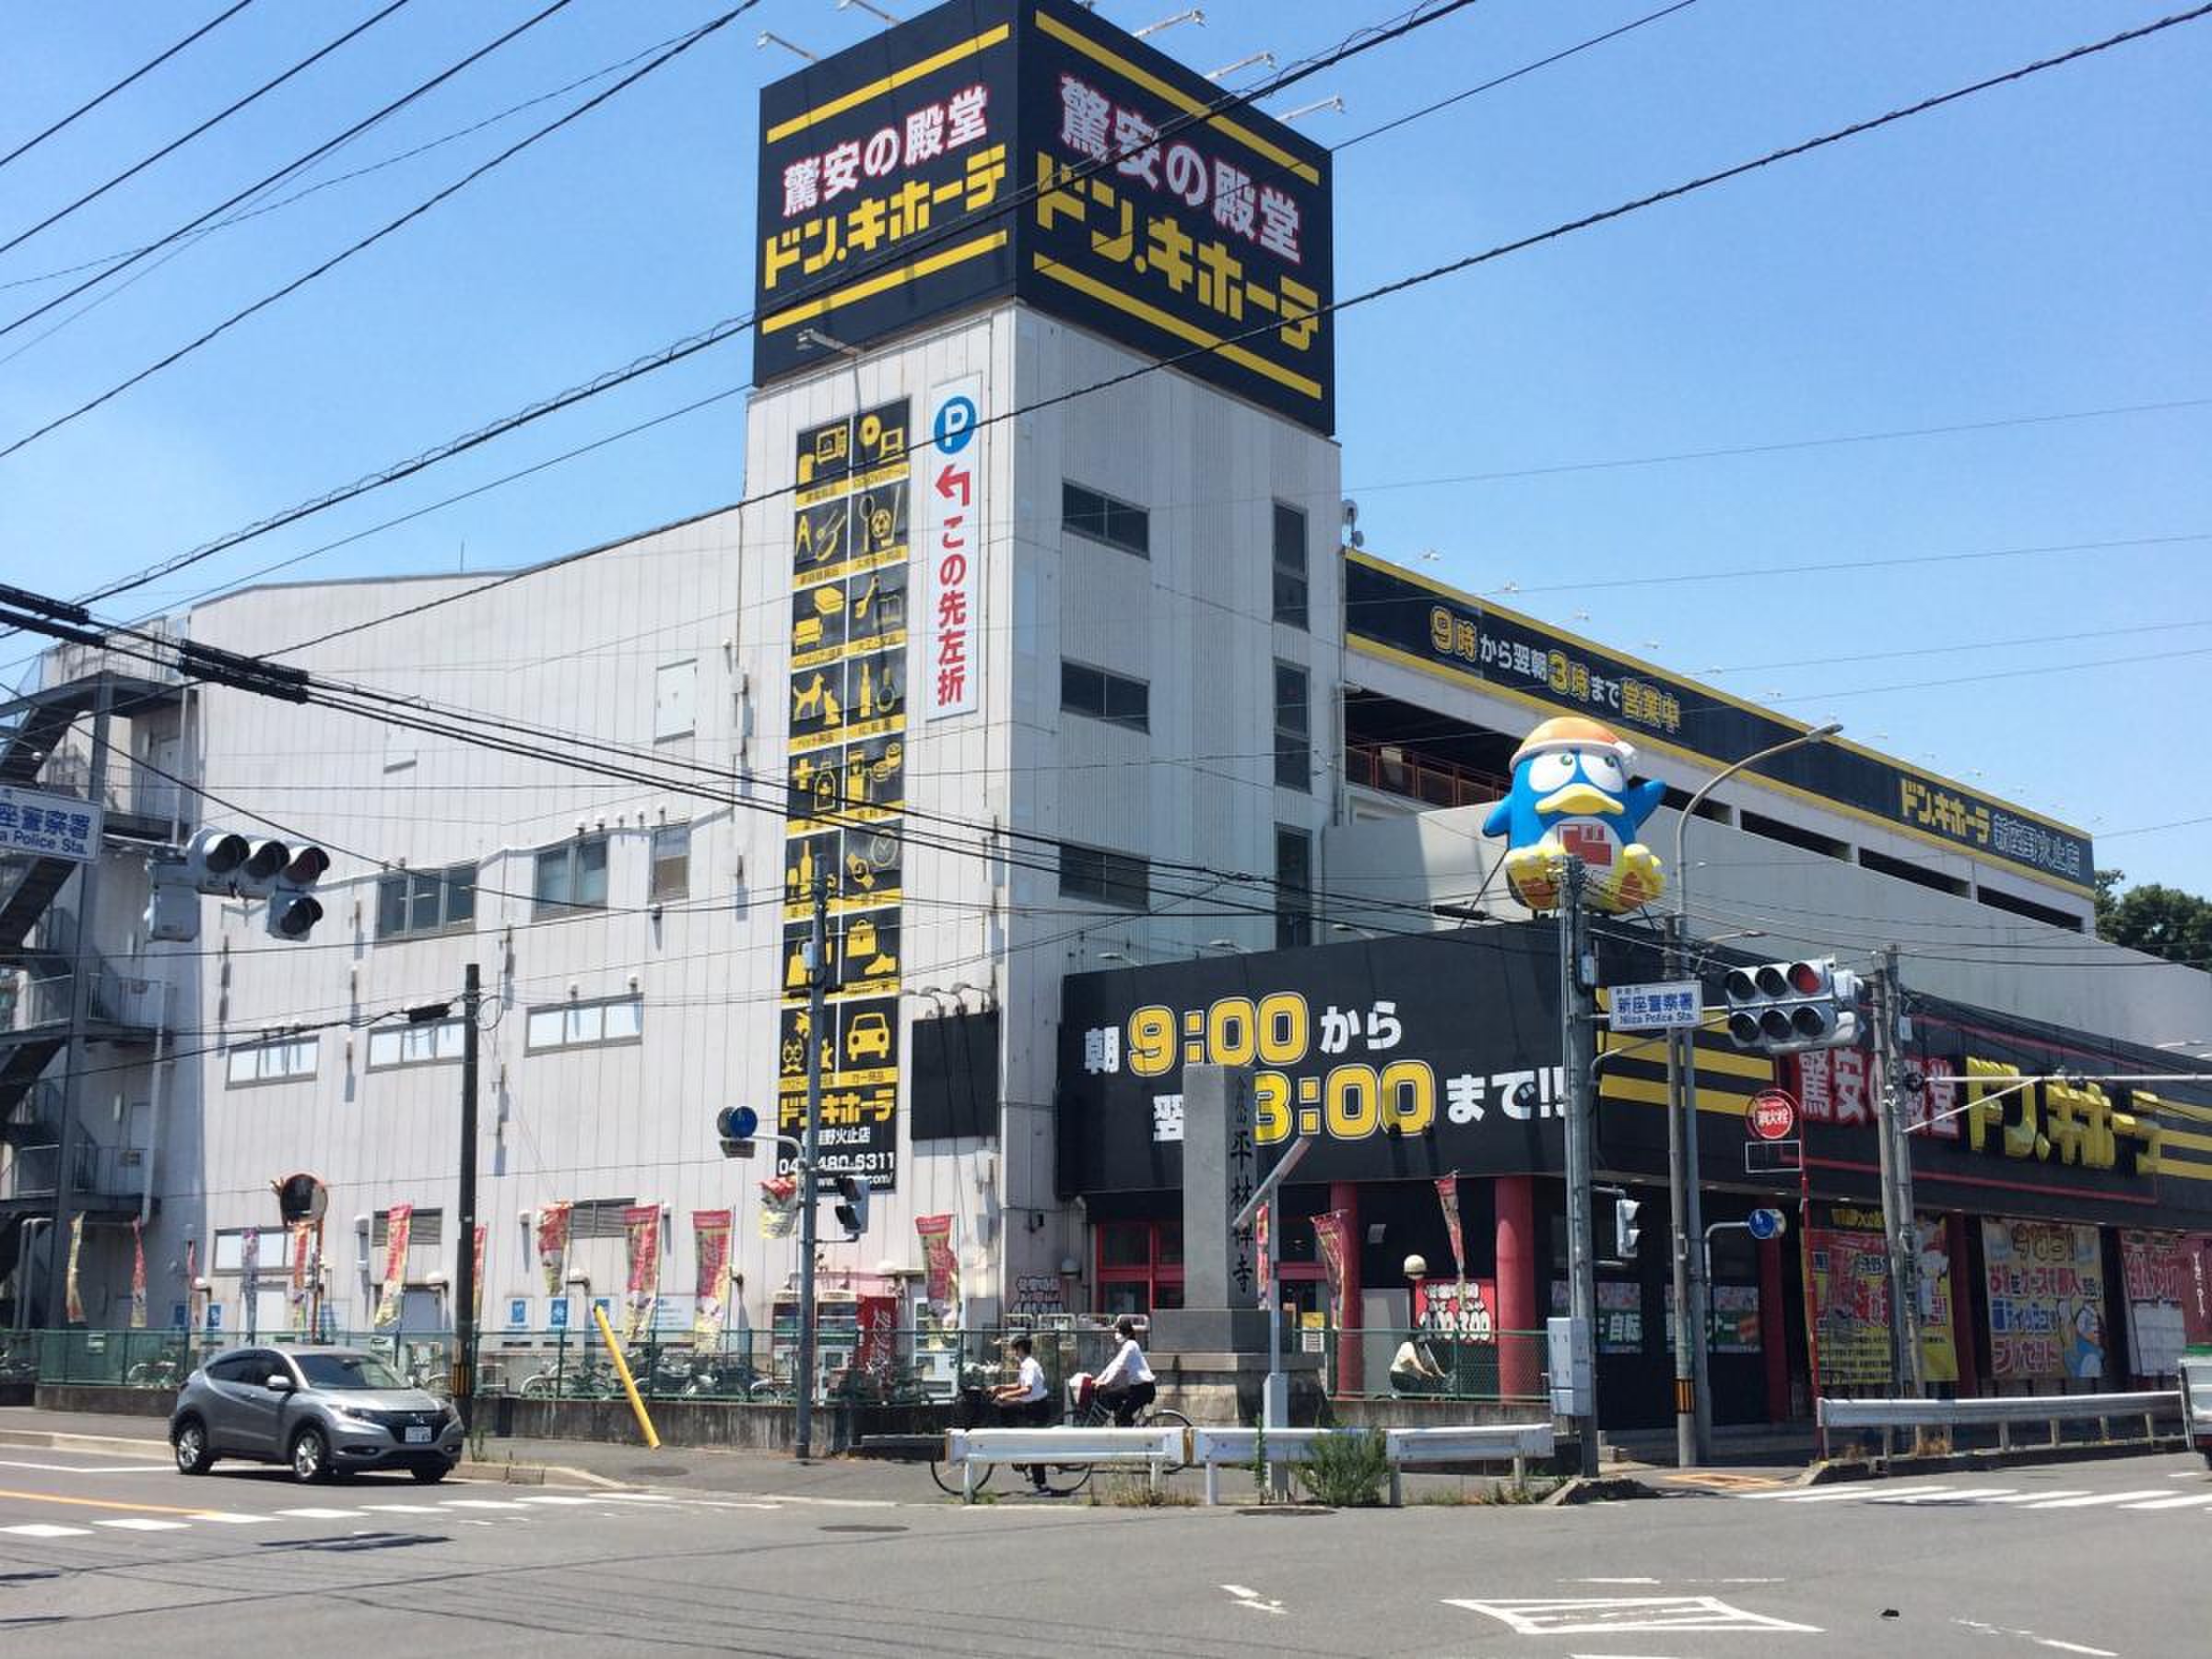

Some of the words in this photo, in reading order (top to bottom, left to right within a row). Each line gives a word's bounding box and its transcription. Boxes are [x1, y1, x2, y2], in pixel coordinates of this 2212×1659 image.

[783, 86, 988, 218] 驚安の殿堂
[1060, 75, 1301, 265] 驚安の殿堂
[944, 403, 969, 447] P
[937, 515, 967, 707] この先左折
[14, 830, 56, 849] Police
[781, 1089, 895, 1128] ドキホーテ
[1153, 1060, 1565, 1146] 翌3:00まで!!
